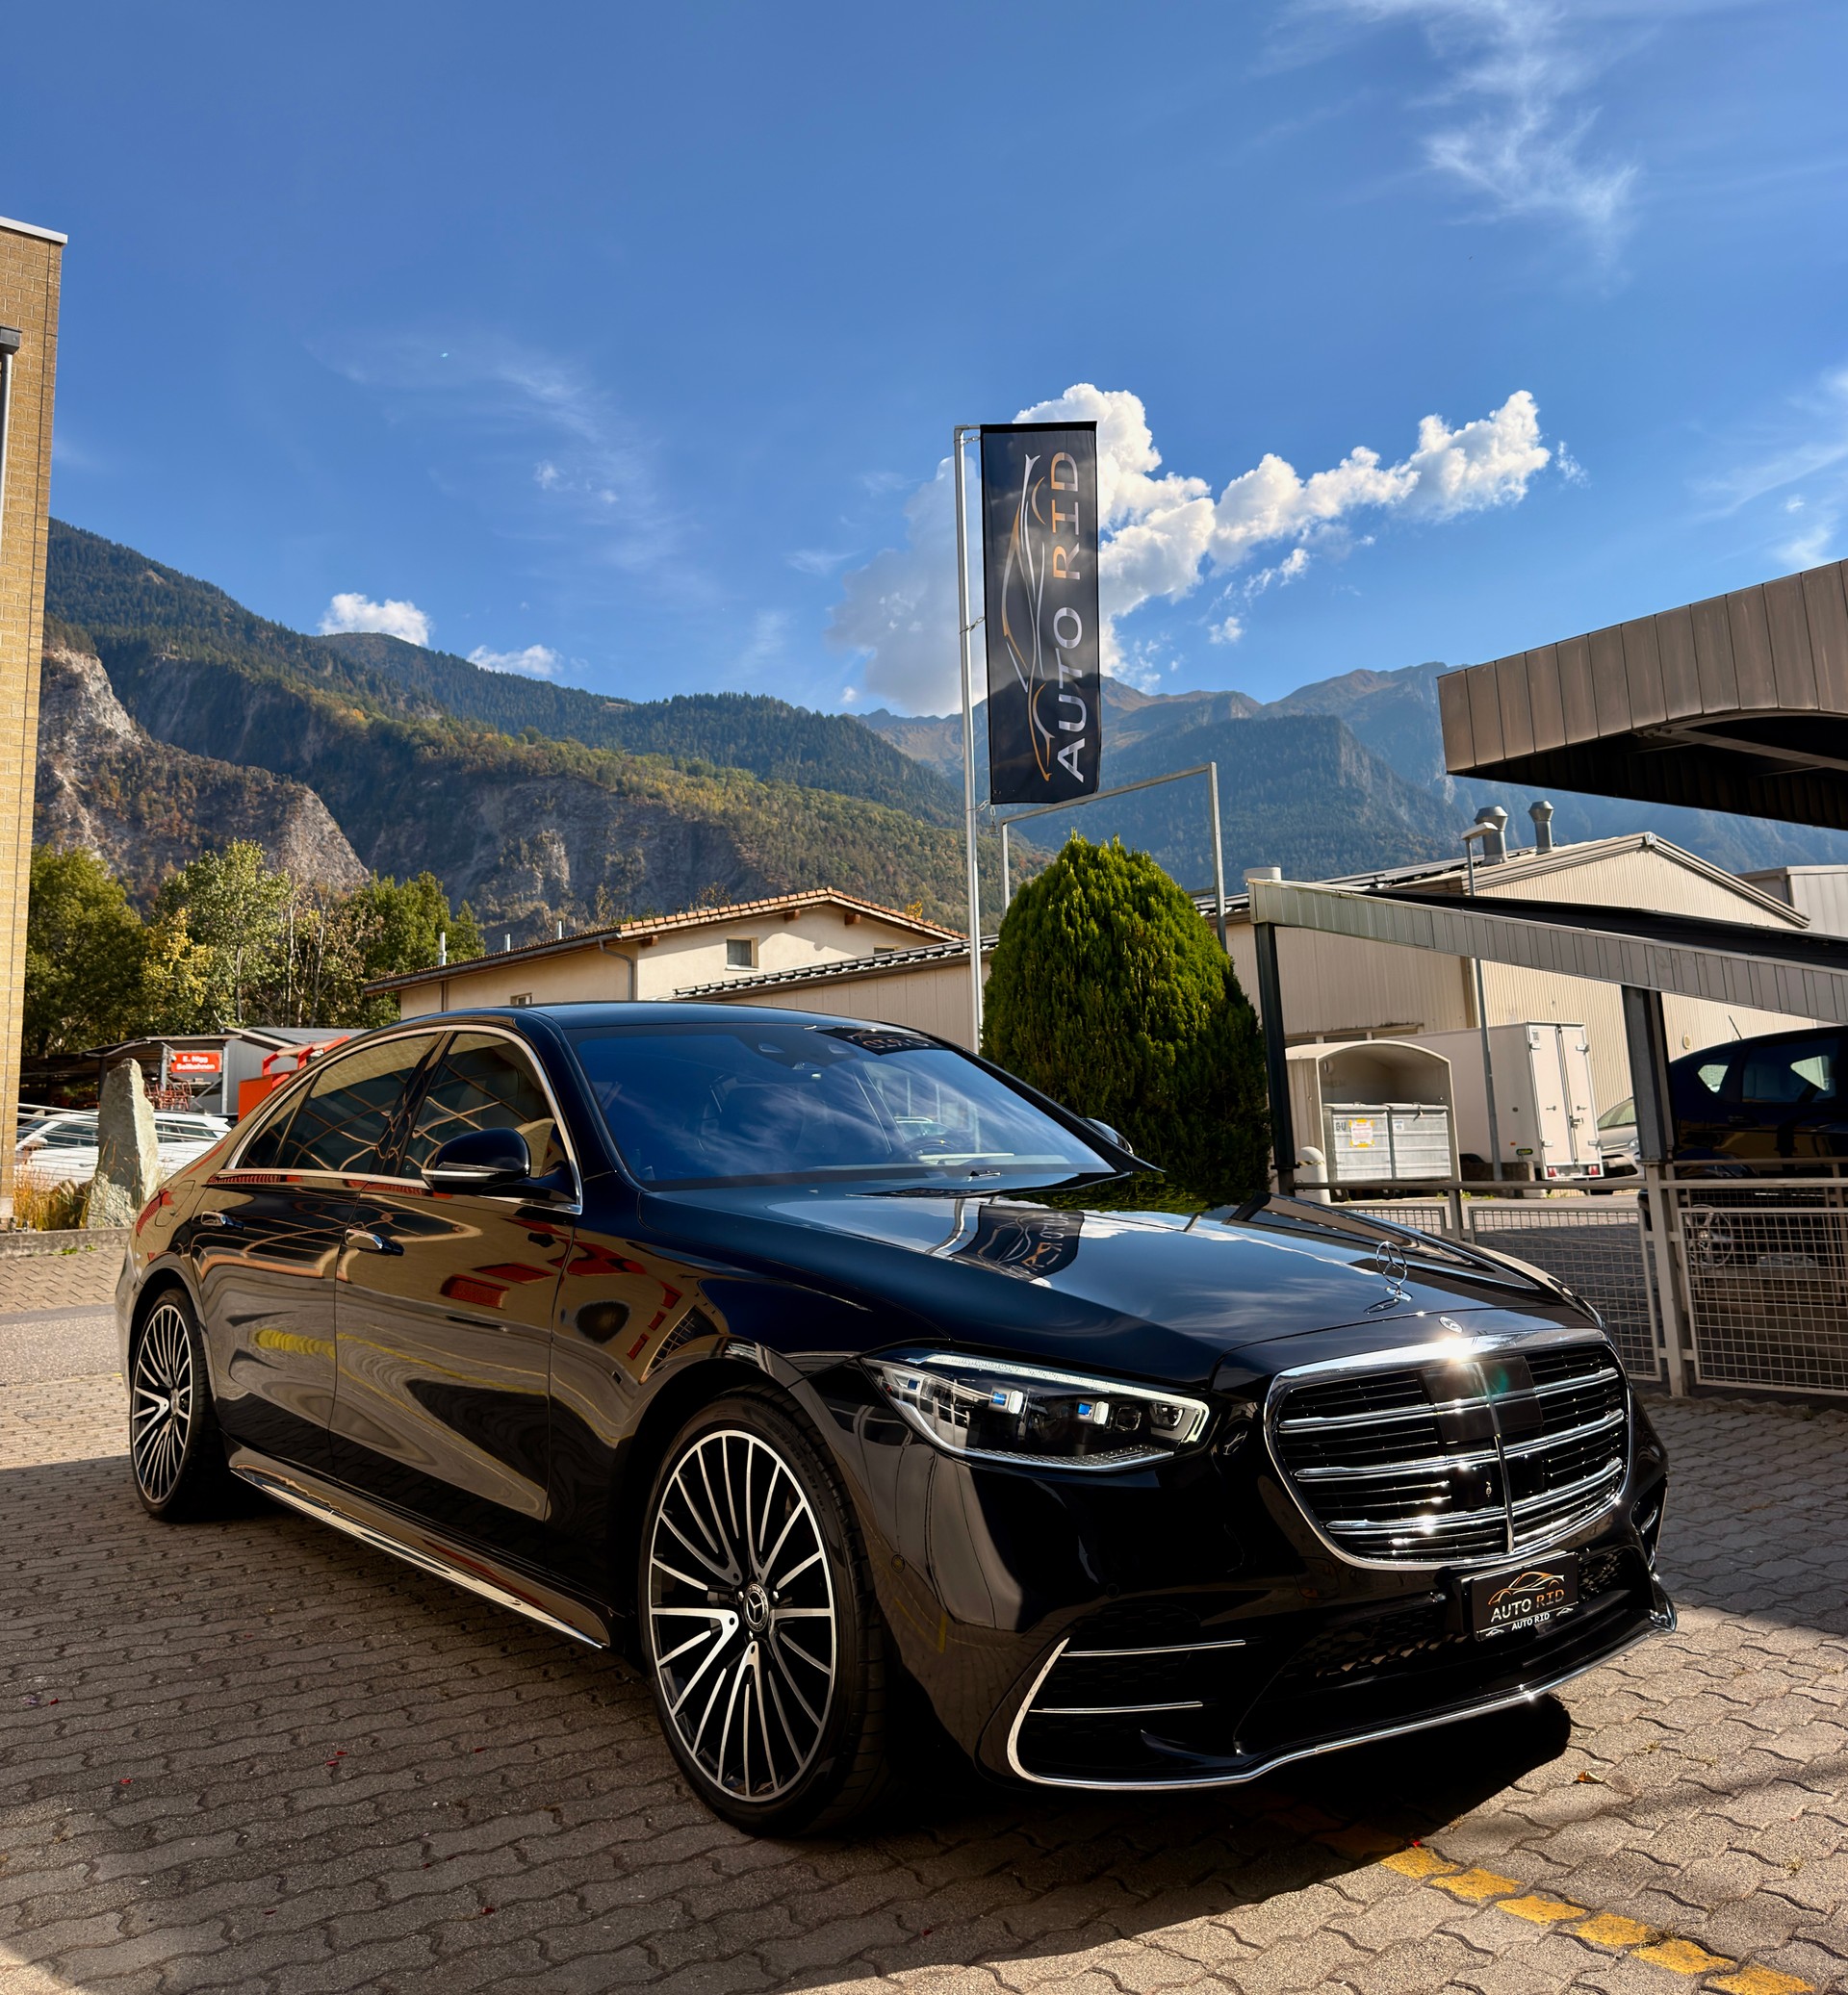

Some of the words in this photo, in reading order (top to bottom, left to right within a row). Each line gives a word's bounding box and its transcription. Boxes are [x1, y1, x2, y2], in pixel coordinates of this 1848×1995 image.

[1051, 451, 1081, 580] RID
[1053, 606, 1087, 782] AUTO
[1491, 1599, 1532, 1623] AUTO
[1536, 1589, 1565, 1608] RID
[1511, 1618, 1533, 1630] AUTO
[1534, 1613, 1550, 1624] RID
